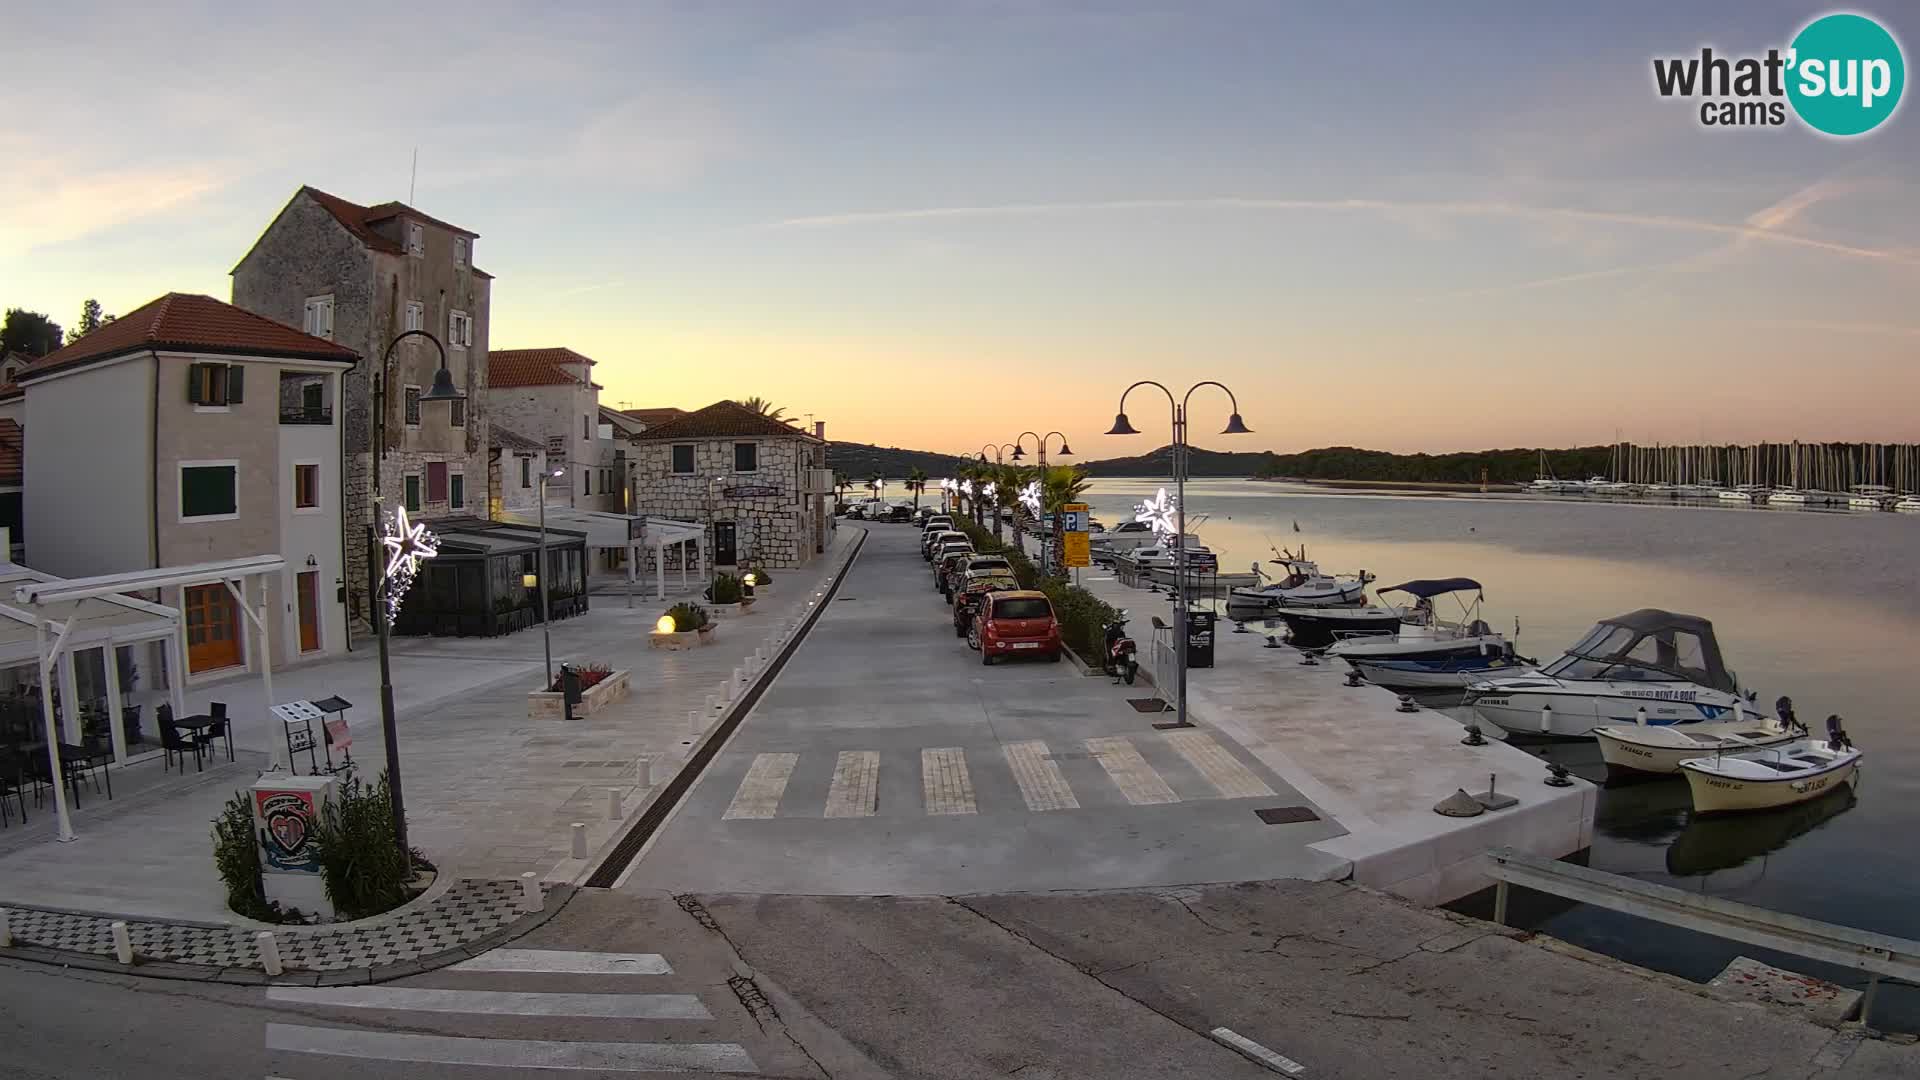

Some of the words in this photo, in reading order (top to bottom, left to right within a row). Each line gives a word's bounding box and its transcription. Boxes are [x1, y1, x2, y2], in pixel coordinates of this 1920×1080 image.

[1066, 514, 1076, 530] P
[1655, 691, 1673, 700] RENT
[1680, 691, 1697, 702] BOAT
